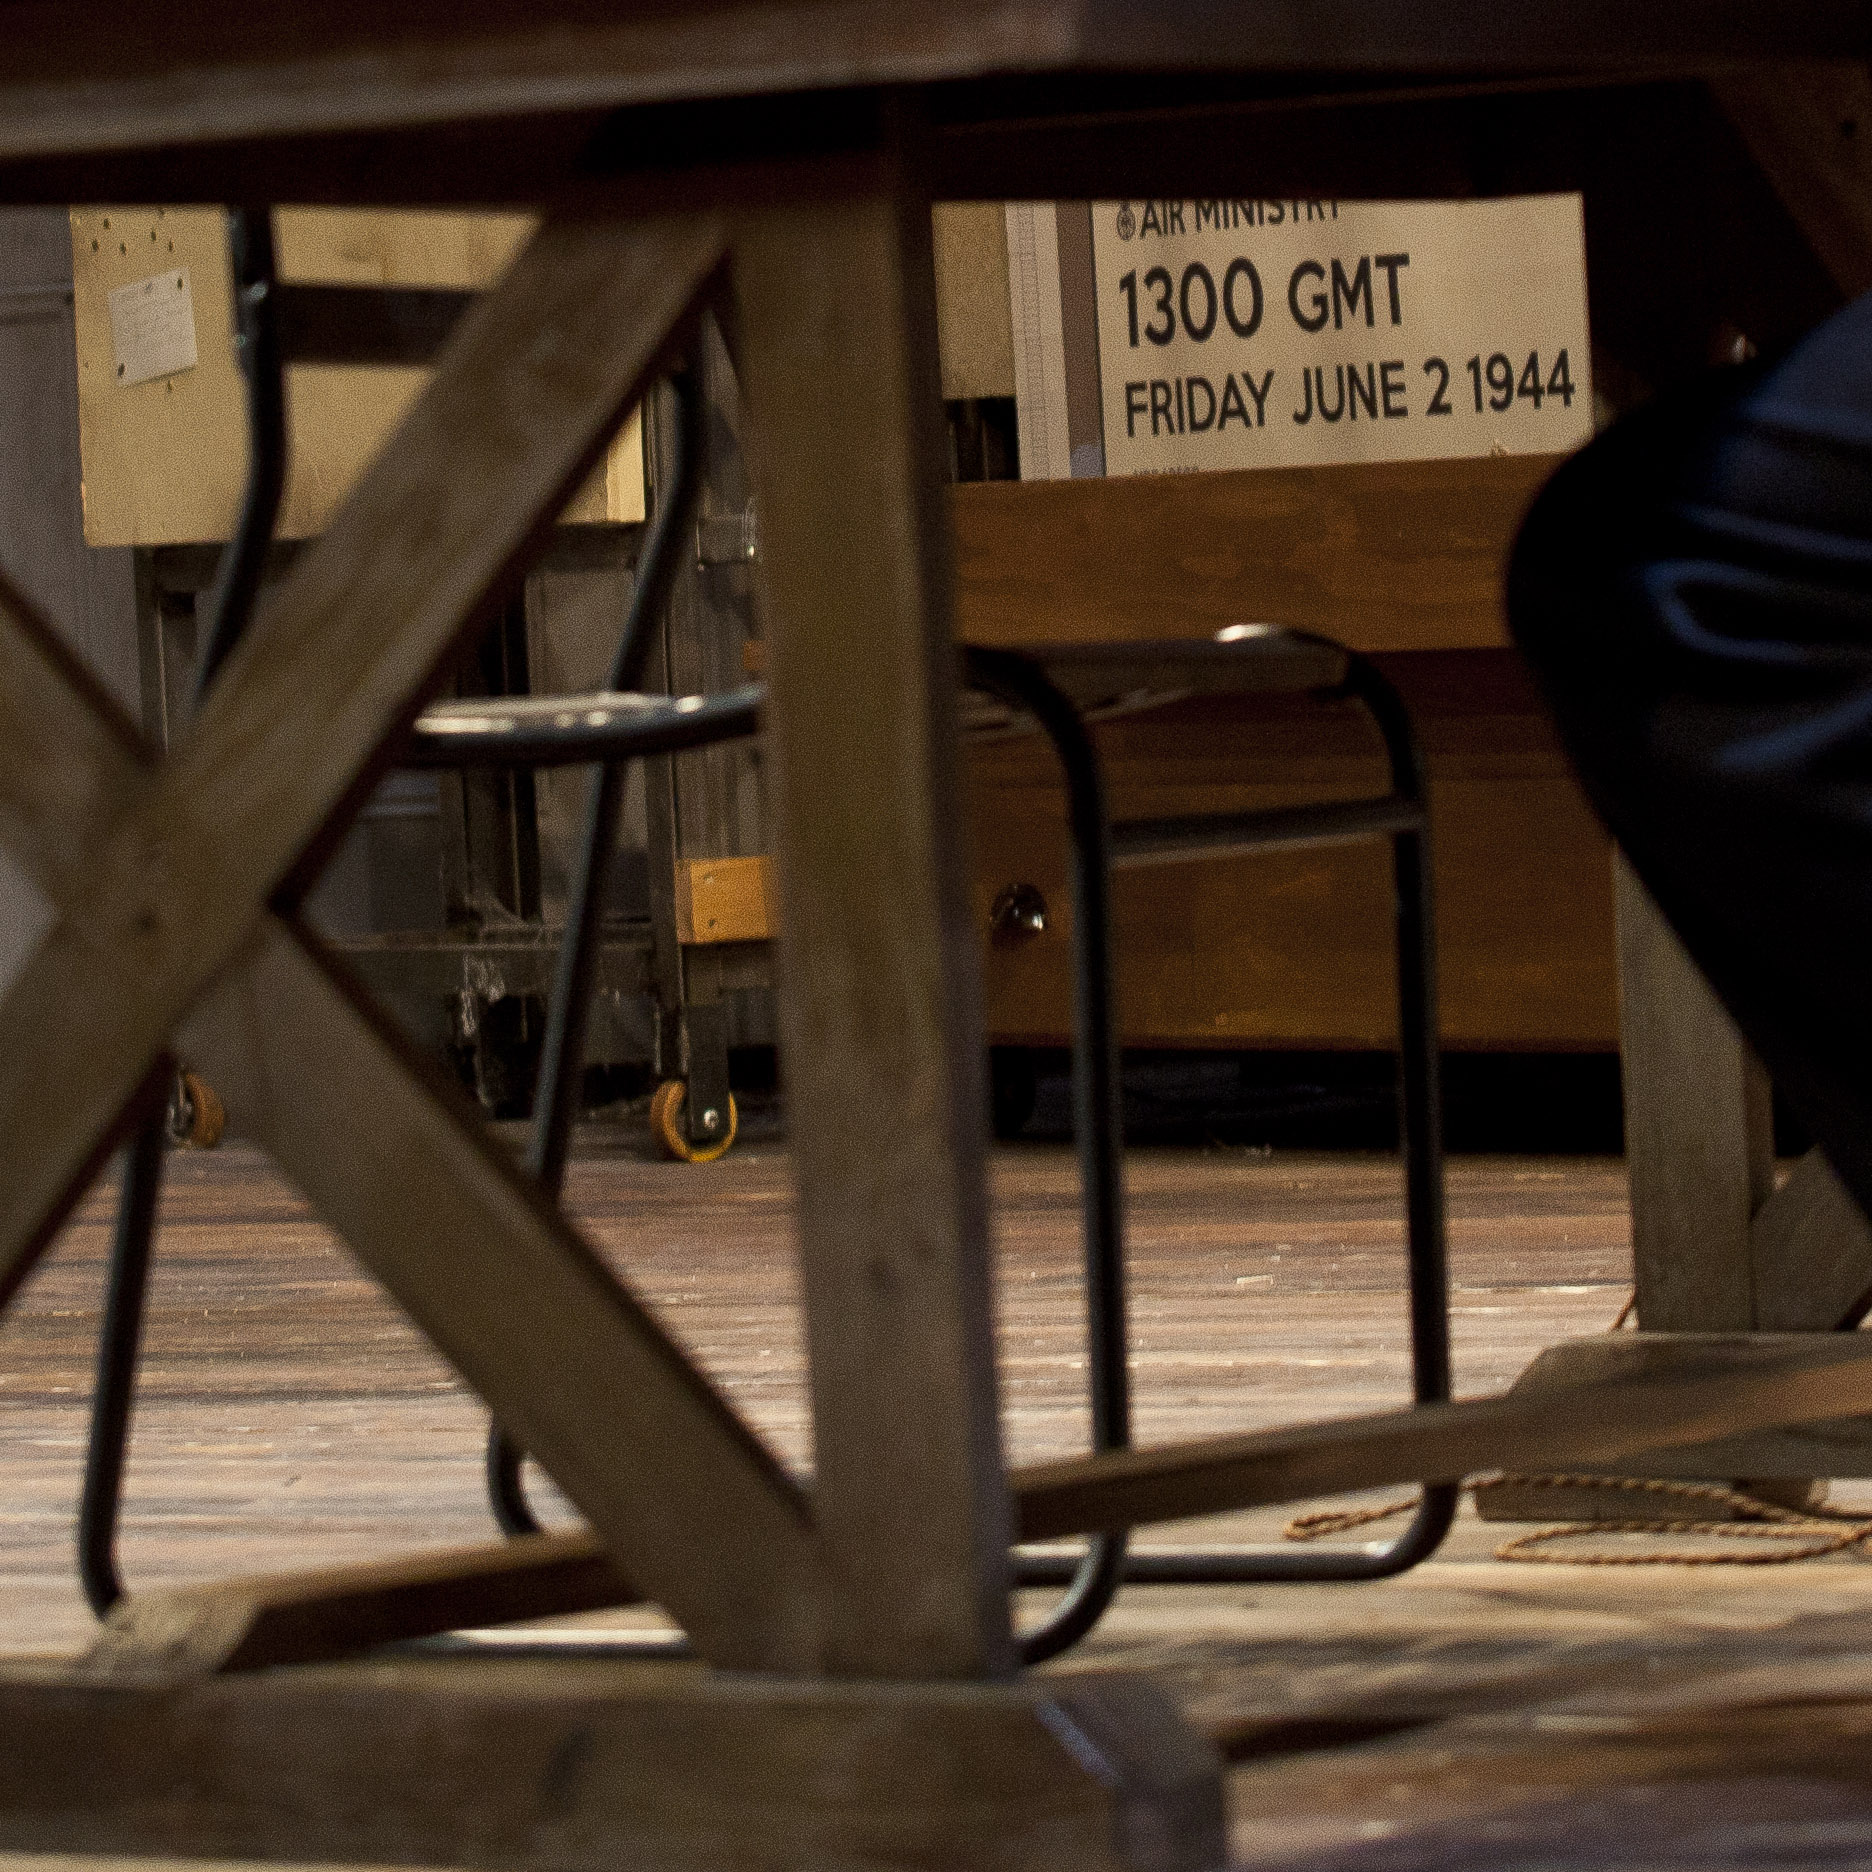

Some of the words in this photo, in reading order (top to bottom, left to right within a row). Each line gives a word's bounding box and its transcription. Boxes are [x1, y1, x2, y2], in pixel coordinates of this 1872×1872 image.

[1139, 200, 1187, 239] AIR
[1118, 257, 1264, 348] 1300
[1287, 254, 1410, 332] GMT
[1124, 371, 1273, 438] FRIDAY
[1293, 361, 1409, 426] JUNE
[1423, 356, 1453, 416] 2
[1468, 348, 1576, 414] 1944
